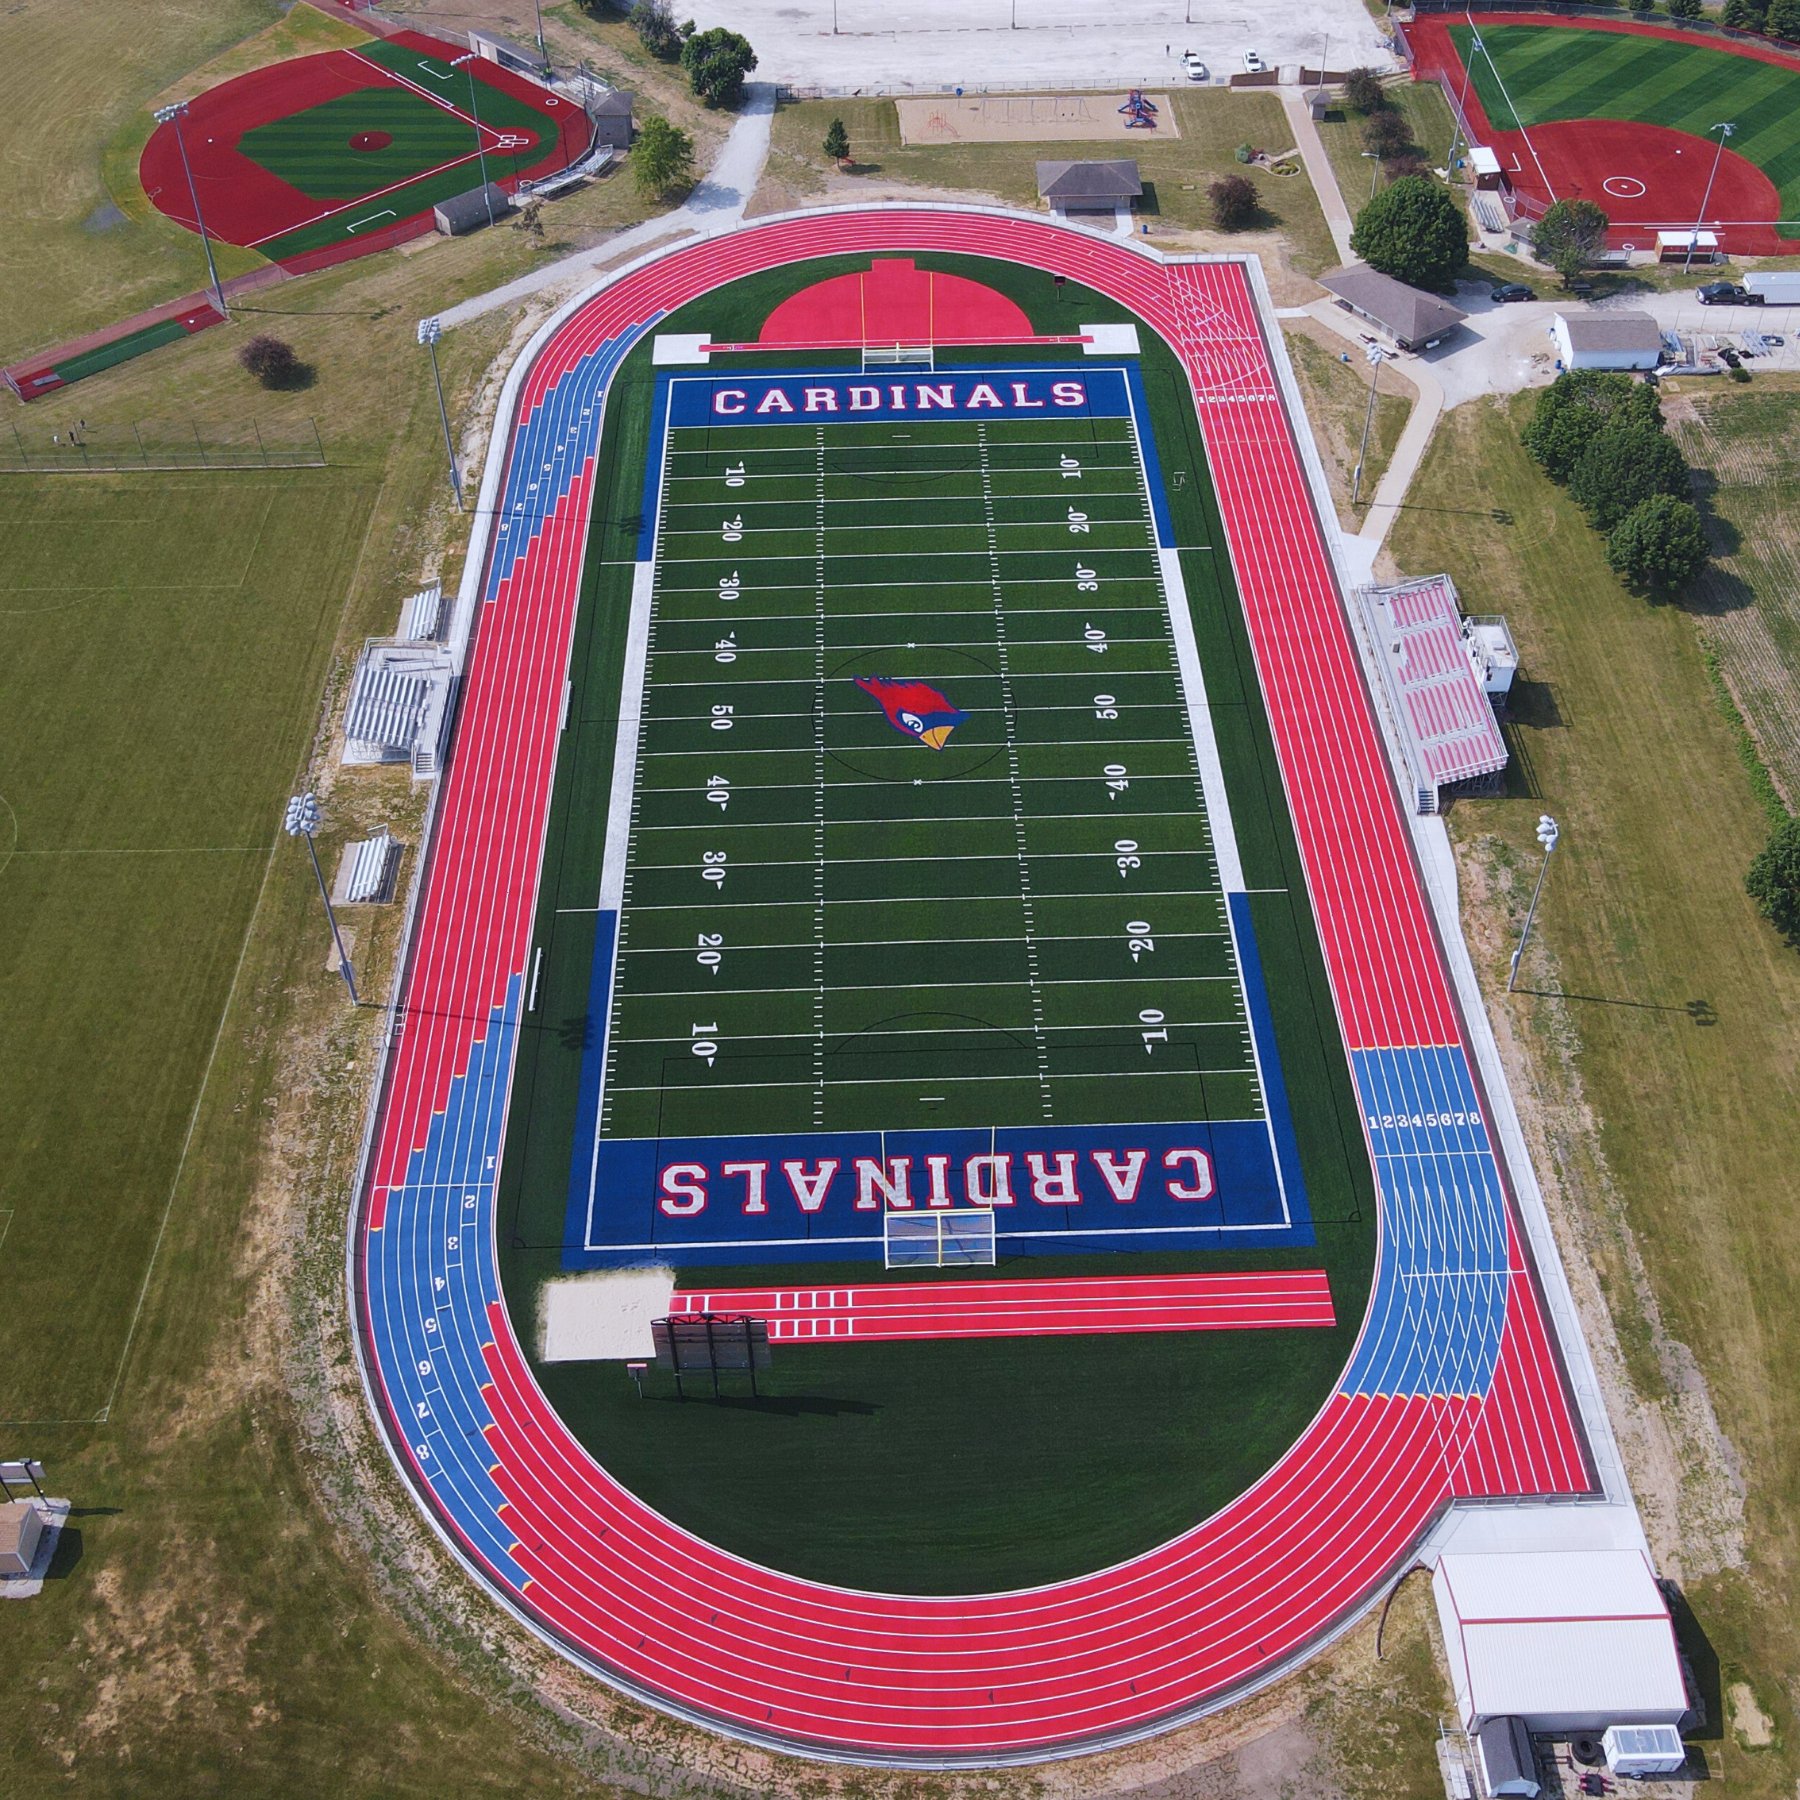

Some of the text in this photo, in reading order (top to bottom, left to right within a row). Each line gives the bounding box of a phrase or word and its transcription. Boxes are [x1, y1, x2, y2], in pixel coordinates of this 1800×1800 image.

[712, 381, 1087, 415] CARDINALS
[726, 467, 745, 486] 10
[1060, 460, 1081, 478] 10
[722, 521, 742, 541] 20
[1068, 513, 1089, 532] 20
[719, 579, 739, 599] 30
[1076, 569, 1098, 591] 30
[715, 640, 736, 662] 40
[1085, 630, 1107, 653] 40
[711, 705, 733, 729] 50
[1094, 695, 1118, 719] 50
[707, 776, 729, 801] 40
[1104, 765, 1128, 790] 40
[1115, 840, 1140, 868] 30
[702, 852, 726, 880] 30
[1127, 922, 1154, 951] 20
[697, 934, 722, 964] 20
[1139, 1009, 1167, 1042] 10
[692, 1022, 718, 1055] 10
[1367, 1112, 1481, 1129] 1 2 3 4 5 6 7 8
[486, 1156, 494, 1169] 1
[659, 1147, 1214, 1217] CARDINALS
[464, 1195, 475, 1208] 2
[447, 1237, 458, 1250] 3
[434, 1277, 445, 1291] 4
[425, 1318, 437, 1333] 5
[419, 1361, 431, 1375] 6
[416, 1402, 429, 1419] 7
[416, 1445, 429, 1459] 8
